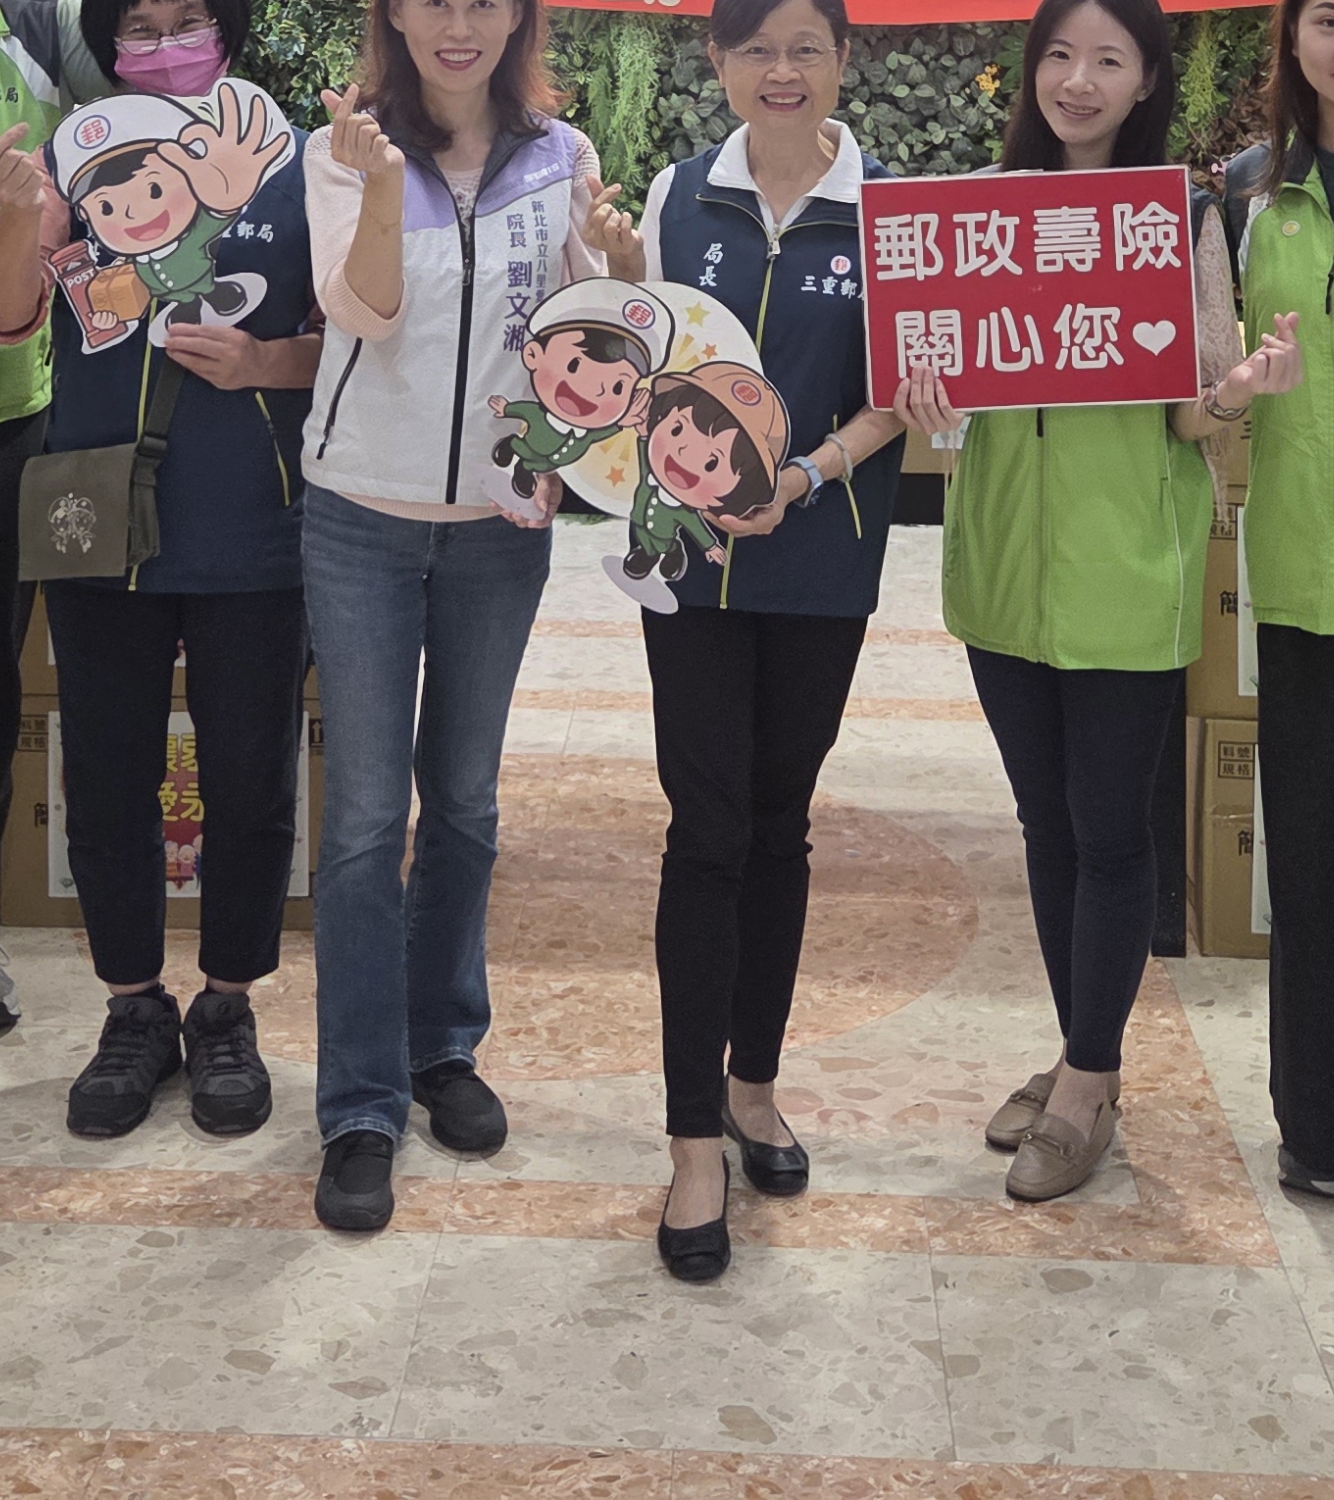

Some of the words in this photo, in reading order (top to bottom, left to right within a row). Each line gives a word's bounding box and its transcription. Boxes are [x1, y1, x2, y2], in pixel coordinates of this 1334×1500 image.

[506, 213, 526, 248] 院長
[874, 201, 1182, 281] 郵政壽險
[67, 269, 95, 288] POST
[699, 243, 723, 287] 局長
[503, 260, 533, 351] 劉文湘
[801, 275, 866, 300] 三重郵
[895, 303, 1124, 378] 關心您
